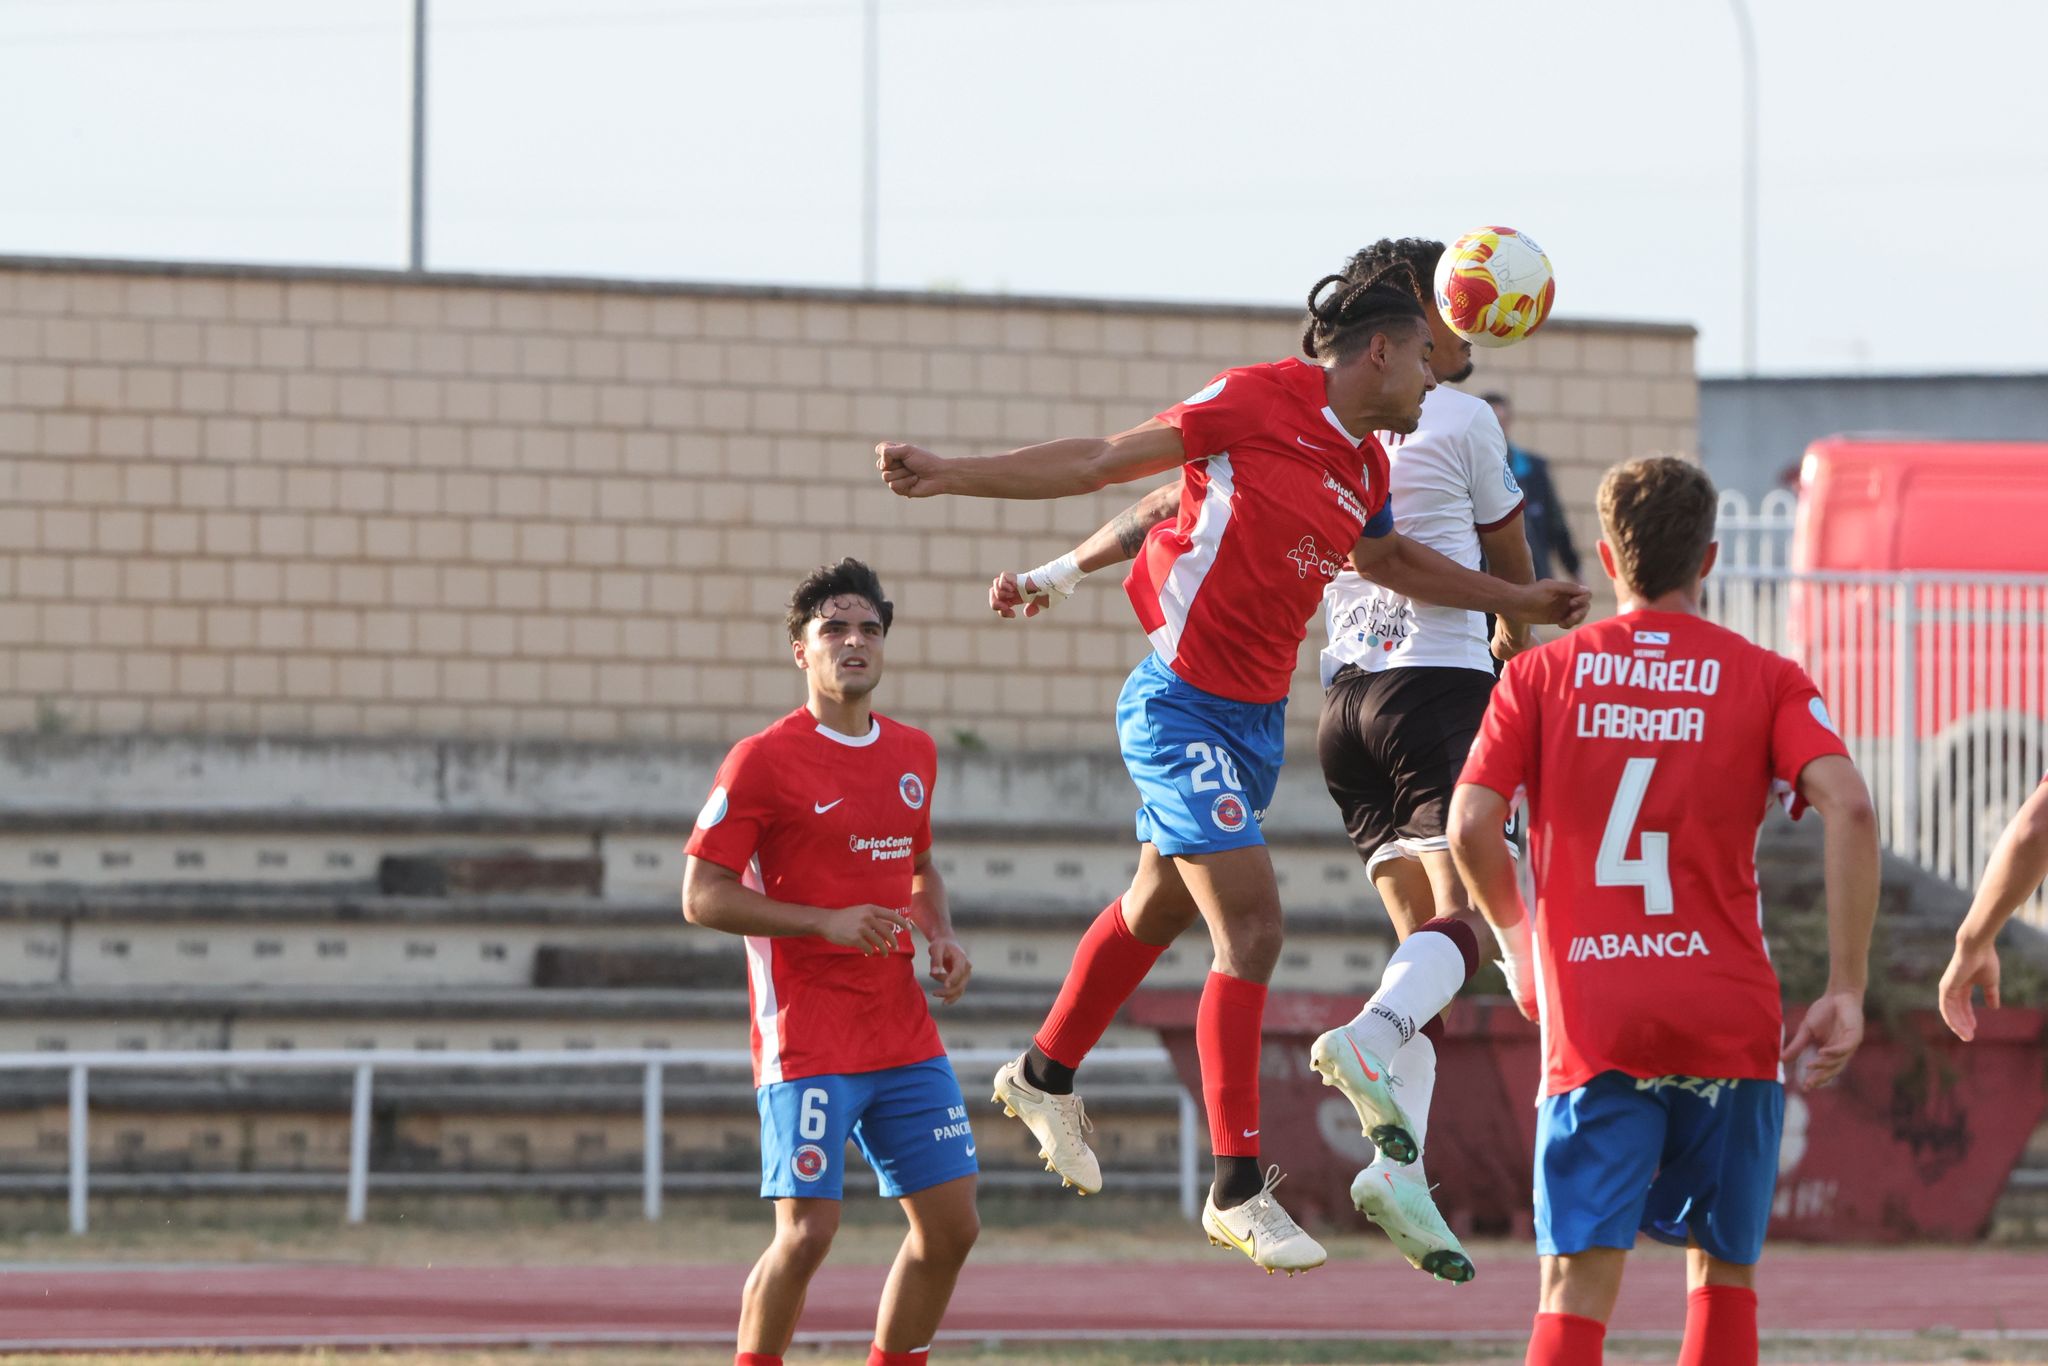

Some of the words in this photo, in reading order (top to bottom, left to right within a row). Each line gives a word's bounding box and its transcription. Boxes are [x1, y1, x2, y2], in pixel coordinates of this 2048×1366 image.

[1574, 652, 1721, 696] POVARELO
[1576, 702, 1705, 743] LABRADA
[1595, 757, 1674, 916] 4
[799, 1087, 829, 1141] 6
